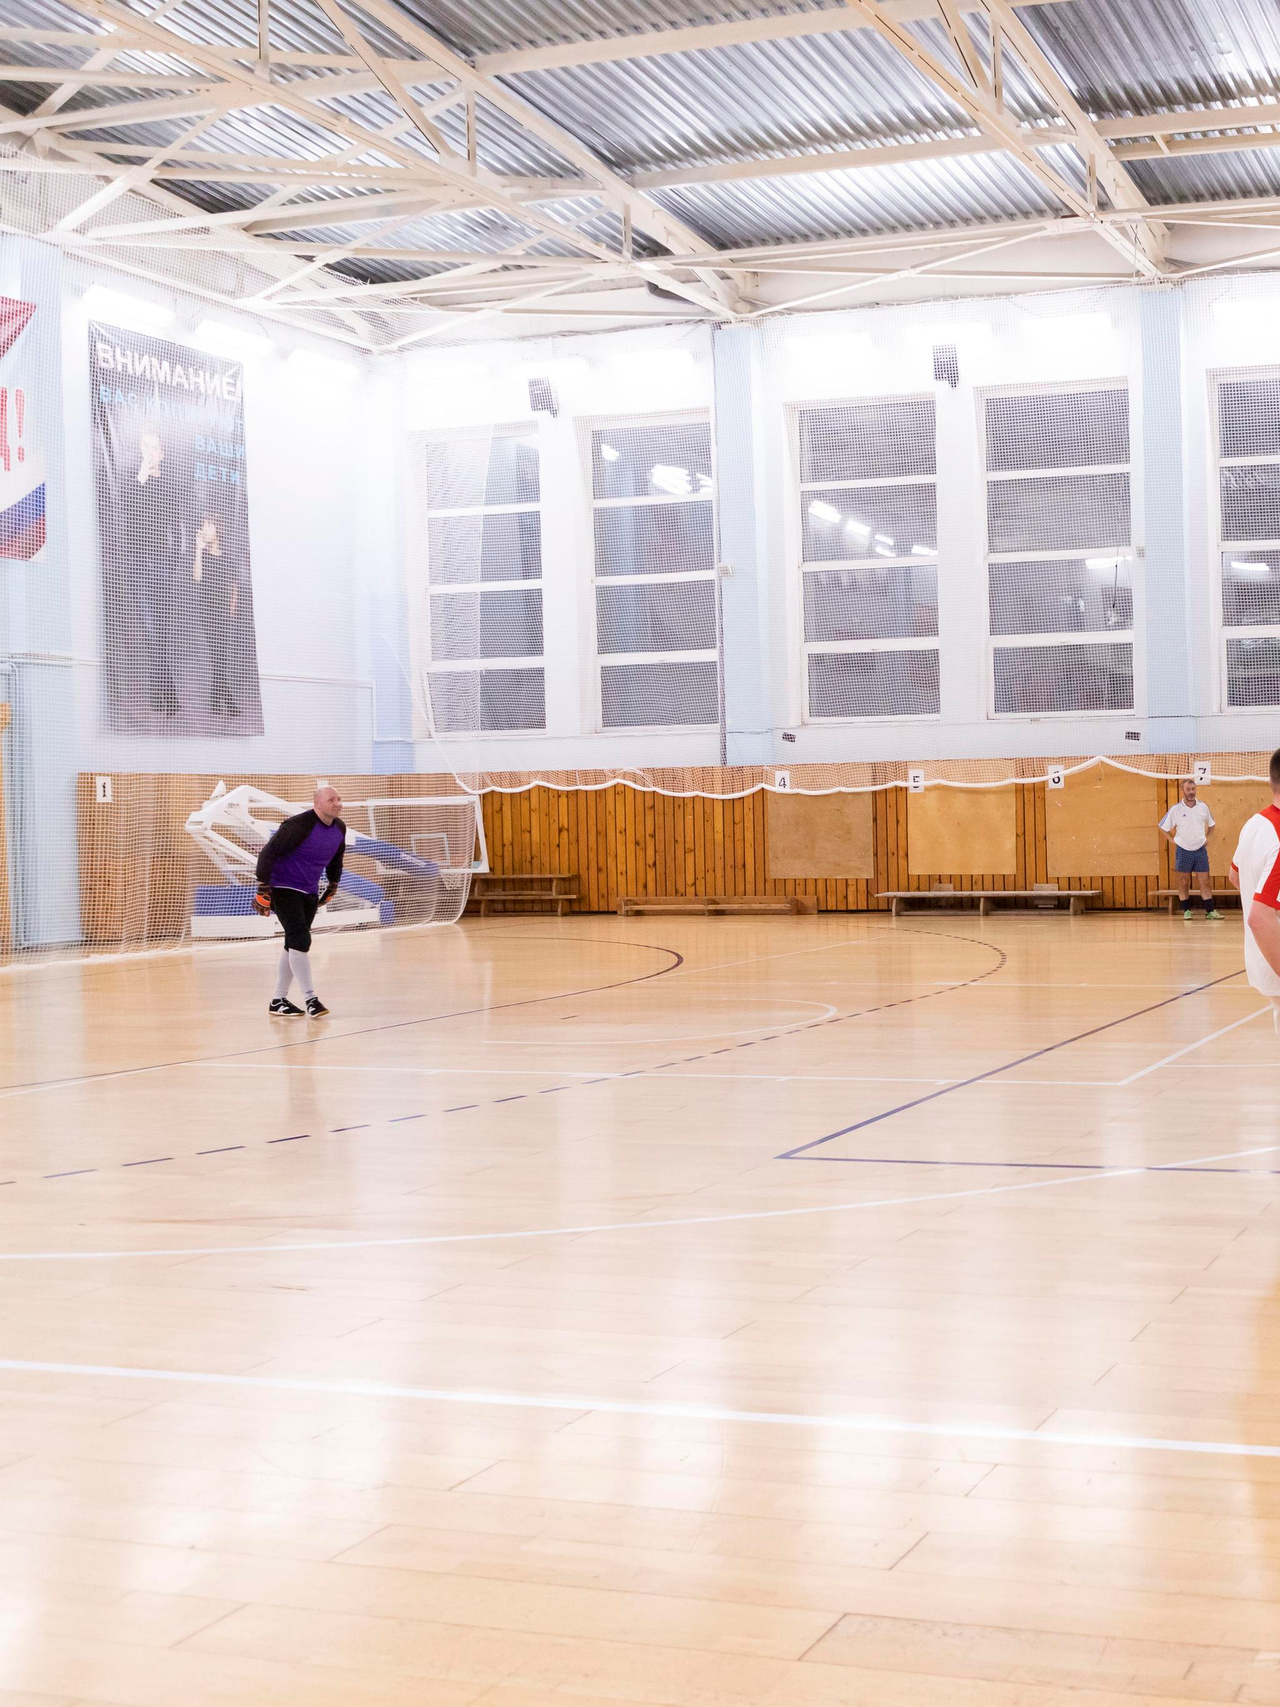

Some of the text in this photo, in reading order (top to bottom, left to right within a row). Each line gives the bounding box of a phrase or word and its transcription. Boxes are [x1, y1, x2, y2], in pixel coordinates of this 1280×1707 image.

[194, 434, 244, 459] ВАШИ
[194, 460, 240, 484] ДЕТИ
[778, 776, 787, 789] 4
[1052, 770, 1061, 784] 6
[101, 781, 108, 798] 1
